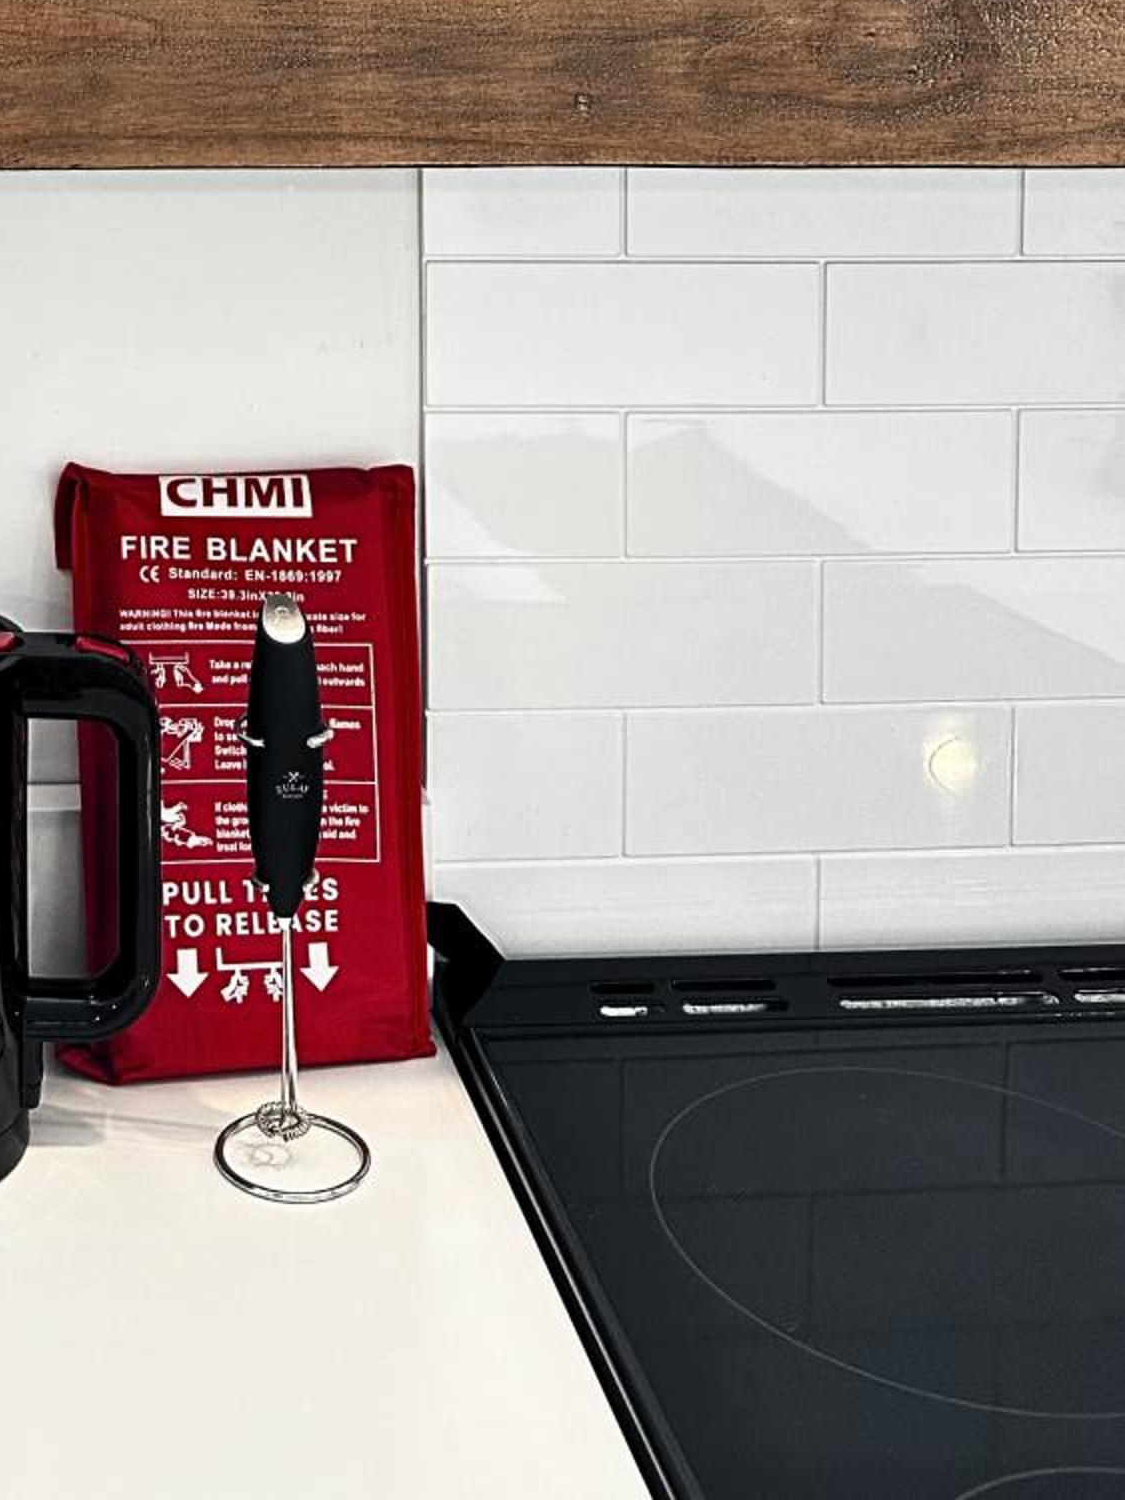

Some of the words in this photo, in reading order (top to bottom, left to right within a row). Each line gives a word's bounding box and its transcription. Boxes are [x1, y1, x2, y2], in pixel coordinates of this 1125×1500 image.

[166, 478, 305, 508] CHMI
[120, 535, 192, 560] FIRE
[206, 537, 359, 564] BLANKET
[168, 567, 238, 581] Standard:
[209, 659, 232, 670] Take
[338, 662, 365, 673] hand
[162, 879, 233, 906] PULL
[164, 913, 205, 939] TO
[216, 908, 339, 936] RELEASE
